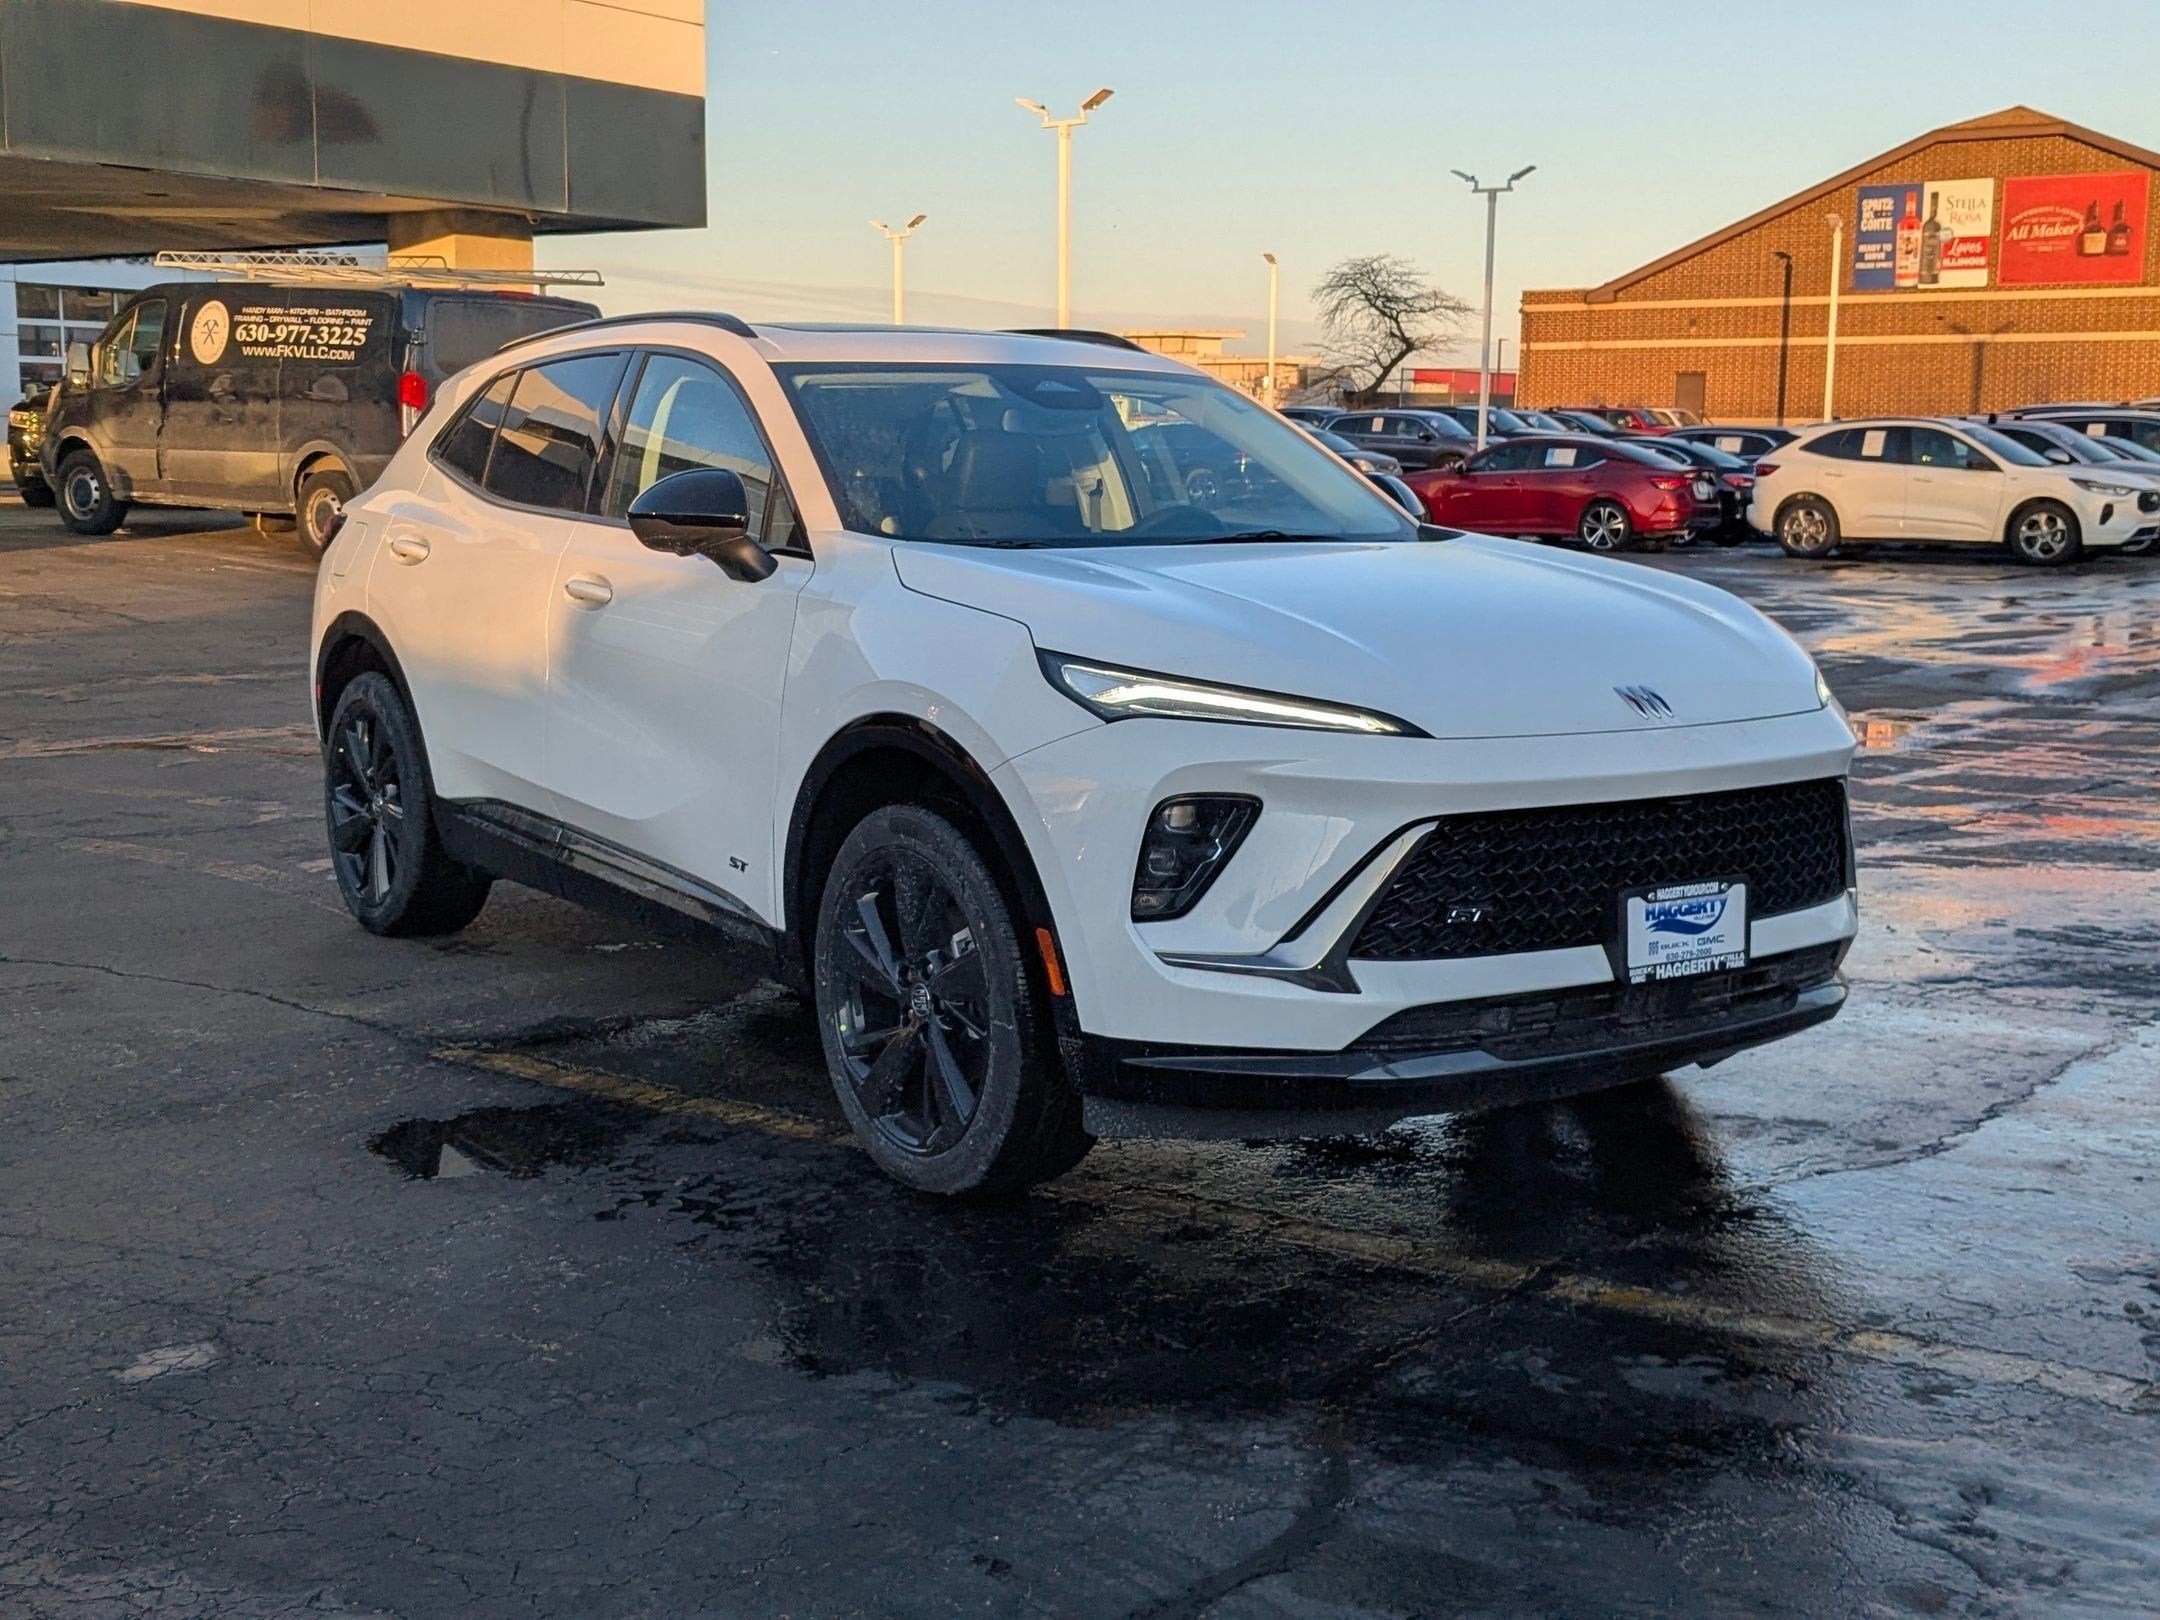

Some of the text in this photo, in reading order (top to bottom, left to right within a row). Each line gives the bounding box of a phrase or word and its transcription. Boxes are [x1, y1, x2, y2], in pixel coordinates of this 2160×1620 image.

[1945, 195, 1986, 211] STELLA
[1861, 217, 1893, 232] CONTE
[1949, 211, 1982, 225] ROSA
[2005, 224, 2031, 241] All
[1947, 238, 1983, 257] Loves
[1942, 256, 1987, 267] ILLINOIS
[242, 306, 266, 315] HANDY
[266, 307, 284, 315] MAN
[289, 307, 320, 316] KITCHEN
[325, 308, 367, 317] BATHROOM
[233, 315, 264, 323] FRAMING
[269, 315, 303, 324] DRYWALL
[309, 316, 344, 325] FLOORING
[350, 318, 374, 326] PAINT
[235, 324, 368, 346] 630-977-3225
[729, 855, 749, 874] ST
[1660, 934, 1726, 951] BUICK GMC
[1655, 955, 1721, 980] HAGGERTY
